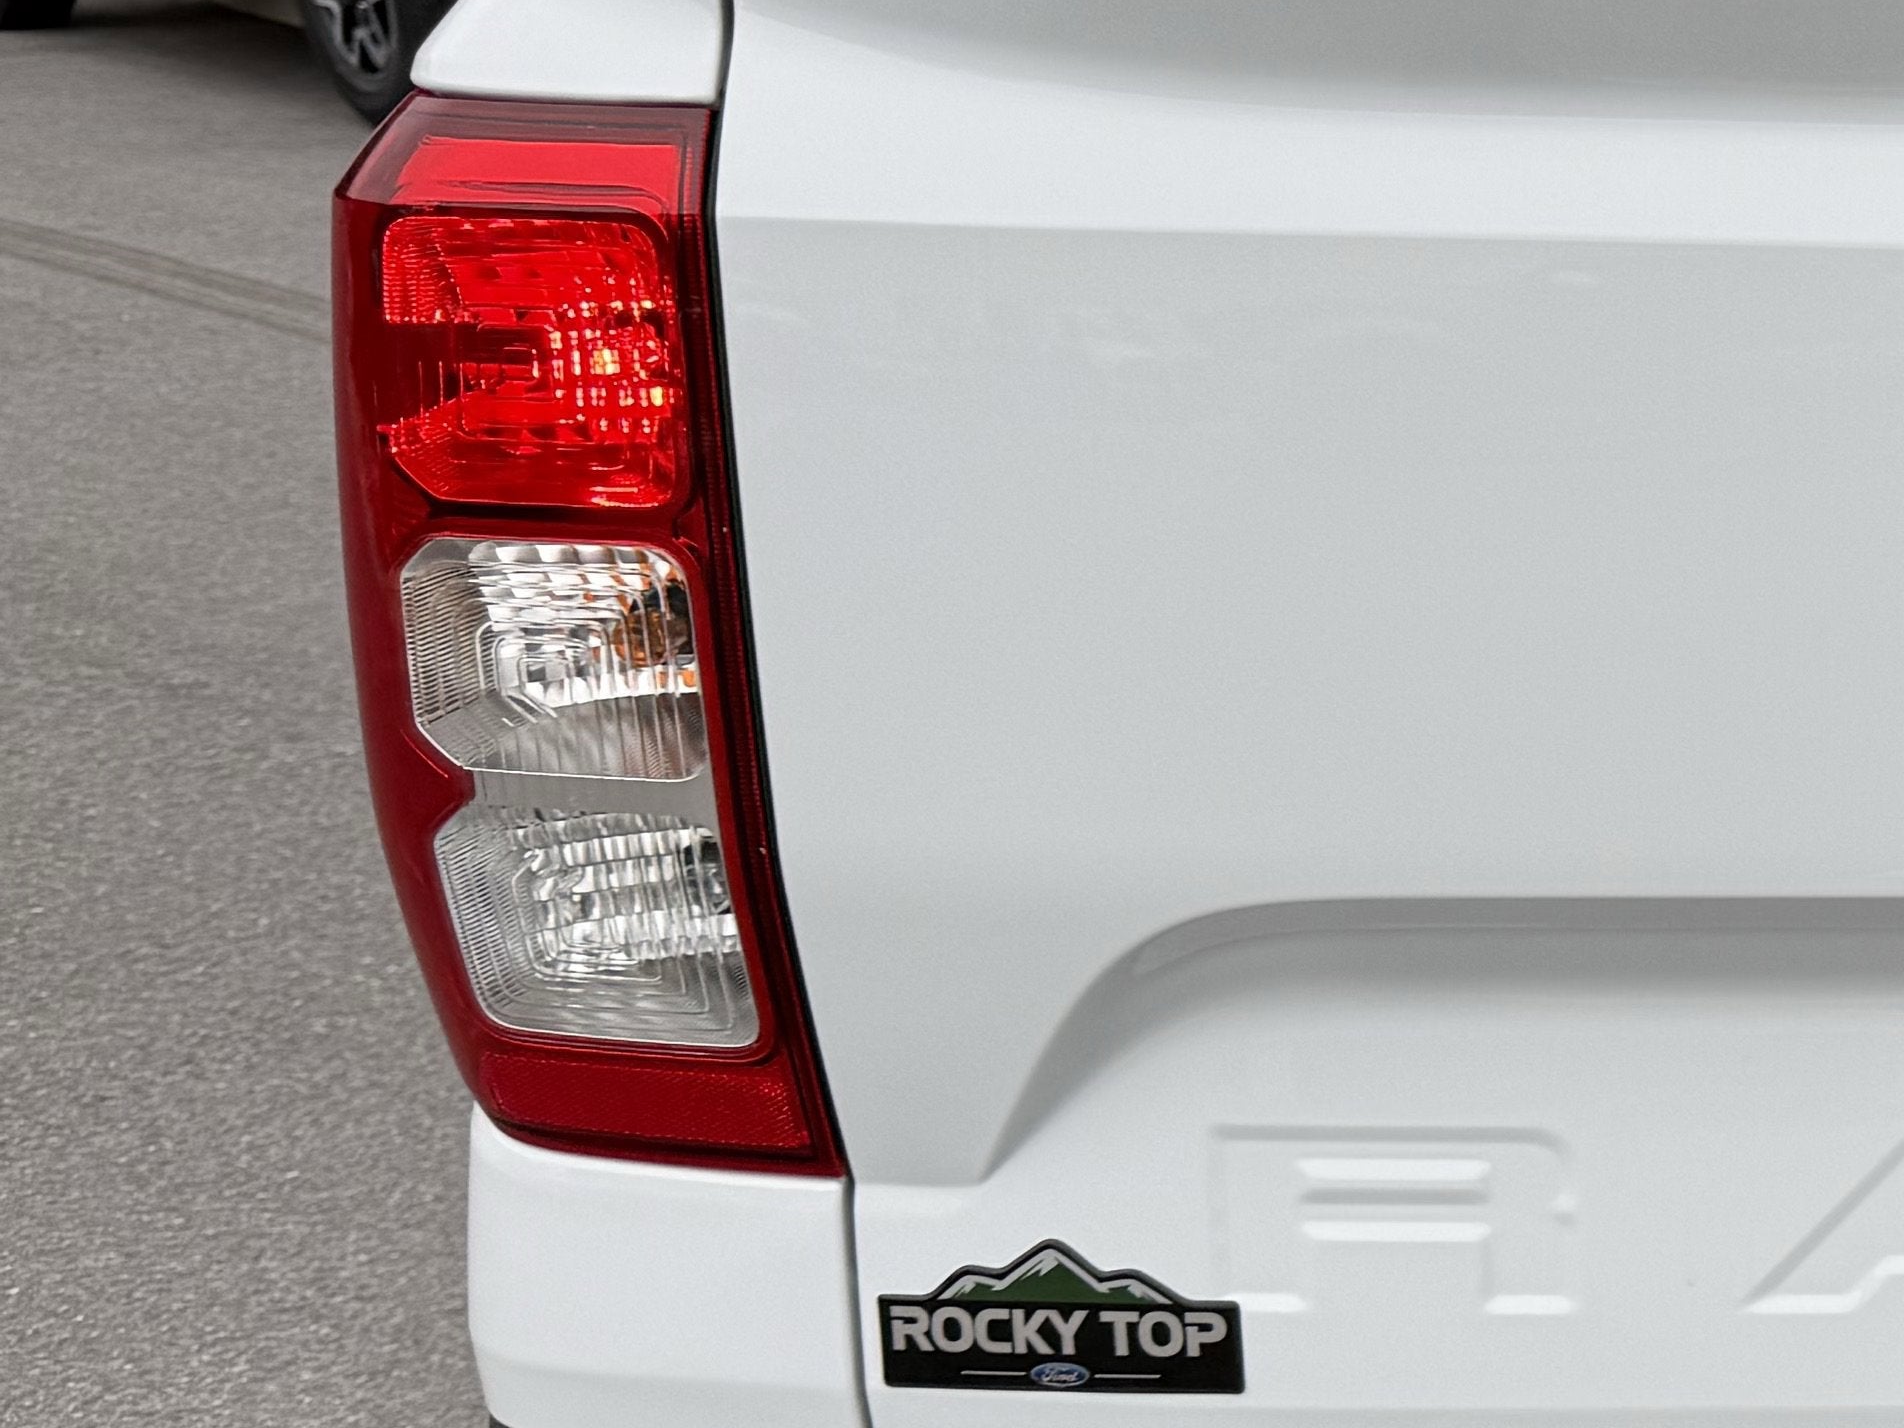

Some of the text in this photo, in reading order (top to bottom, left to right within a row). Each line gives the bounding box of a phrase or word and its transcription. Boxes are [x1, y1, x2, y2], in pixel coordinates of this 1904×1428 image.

[889, 1306, 1227, 1357] ROCKY TOP
[1041, 1367, 1078, 1381] Ford
